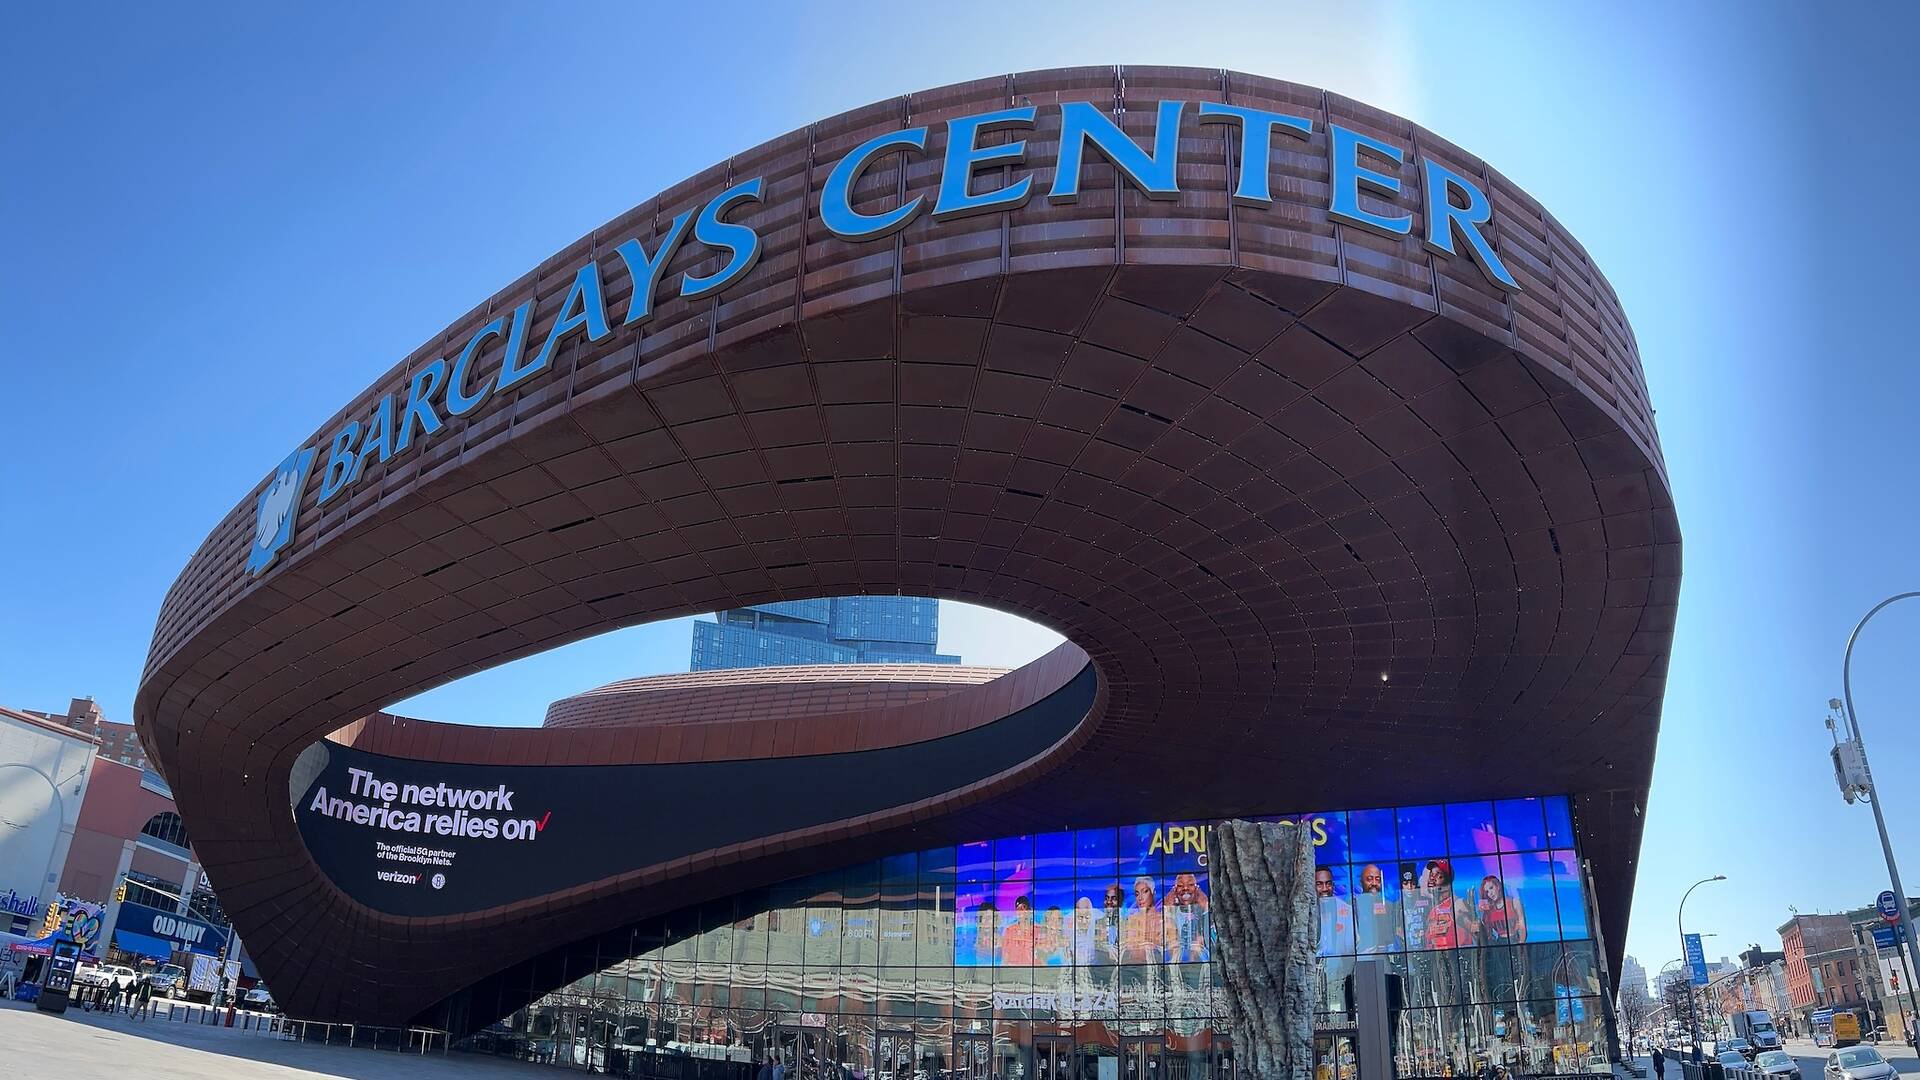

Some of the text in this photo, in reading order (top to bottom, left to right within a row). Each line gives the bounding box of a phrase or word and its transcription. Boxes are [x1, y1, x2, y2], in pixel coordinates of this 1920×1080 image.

[317, 99, 1521, 508] BARCLAYS CENTER
[348, 767, 514, 811] The network
[310, 786, 537, 841] America relies on
[376, 842, 456, 859] The official 5G partner
[1148, 825, 1212, 855] APRI
[377, 851, 452, 866] of the Brooklyn Nets.
[377, 871, 416, 884] verizon
[0, 889, 39, 916] shalls
[153, 915, 206, 943] OLD NAVY
[993, 991, 1117, 1011] SEATGEEK PLAZA
[1315, 1020, 1358, 1031] MAIN ENTR
